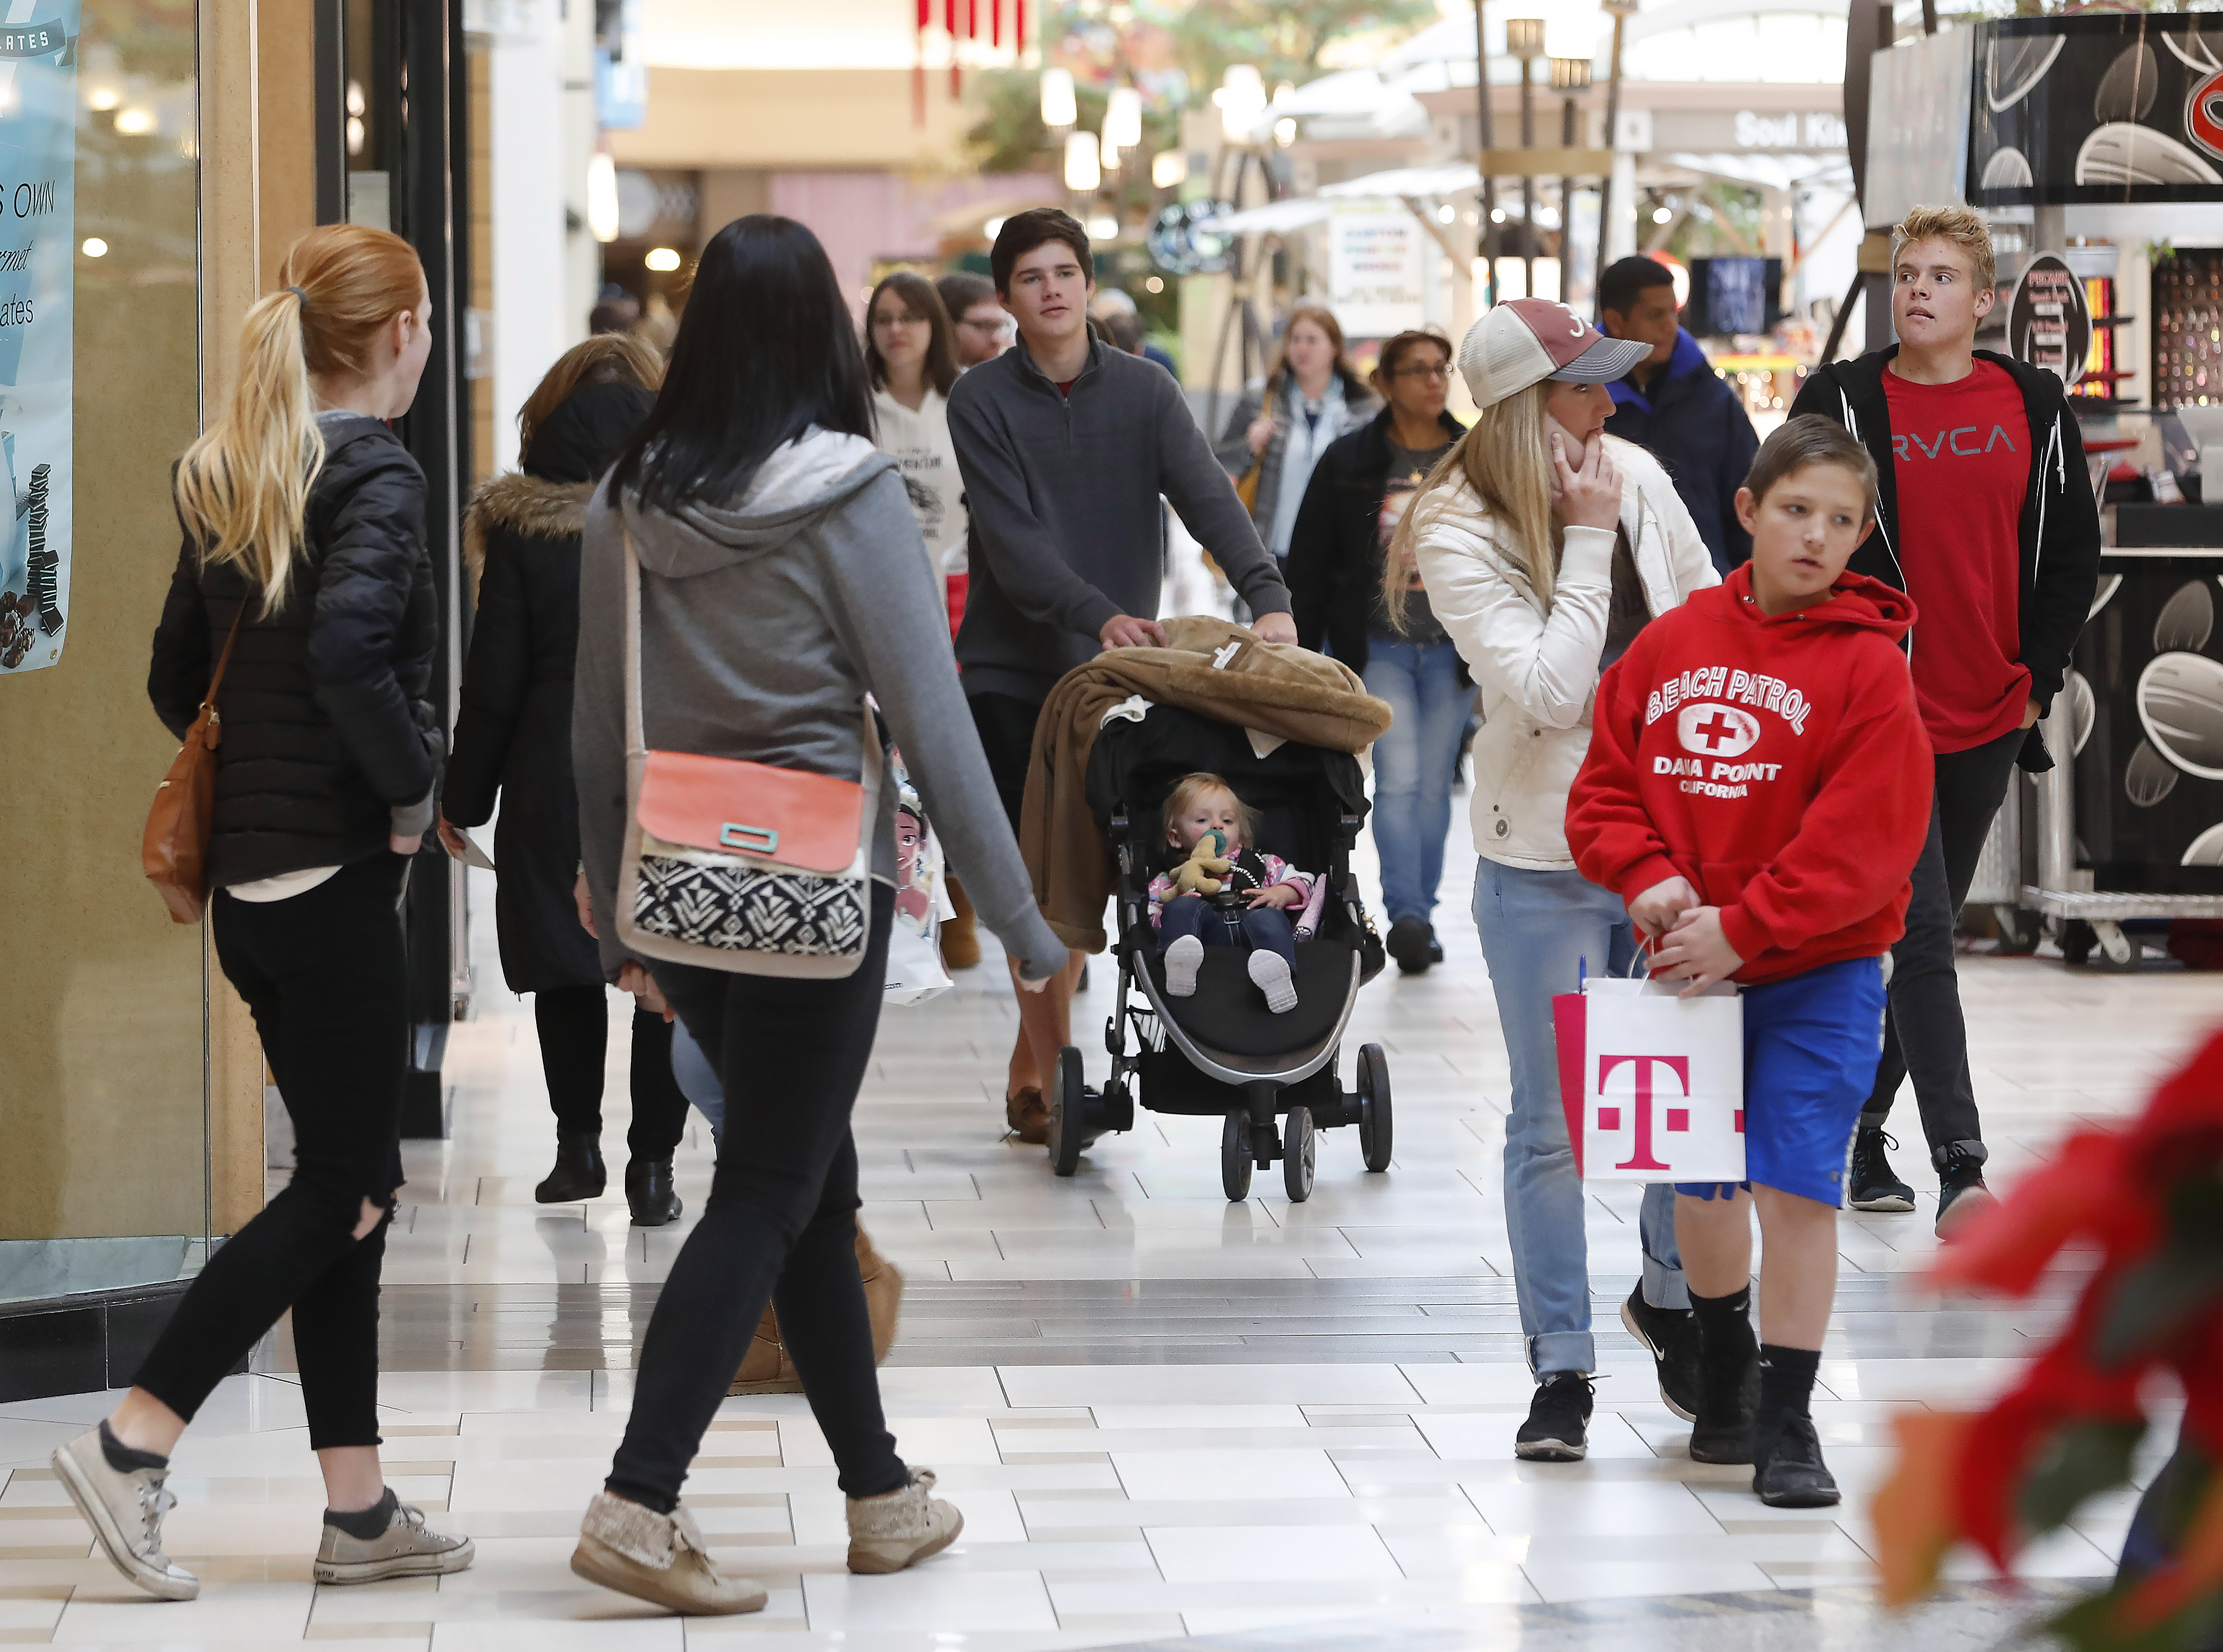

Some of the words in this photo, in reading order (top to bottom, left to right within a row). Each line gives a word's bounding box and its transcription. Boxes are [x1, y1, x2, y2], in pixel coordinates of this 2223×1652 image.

[0, 31, 49, 50] ATES
[1734, 110, 1798, 147] Soul
[14, 180, 55, 218] OWN
[1891, 425, 2016, 462] RVCA
[1646, 666, 1728, 726] BEACH
[1725, 669, 1811, 736] PATROL
[1679, 779, 1748, 799] CIFORNIA
[1711, 762, 1783, 782] POINT
[1598, 1054, 1691, 1171] T
